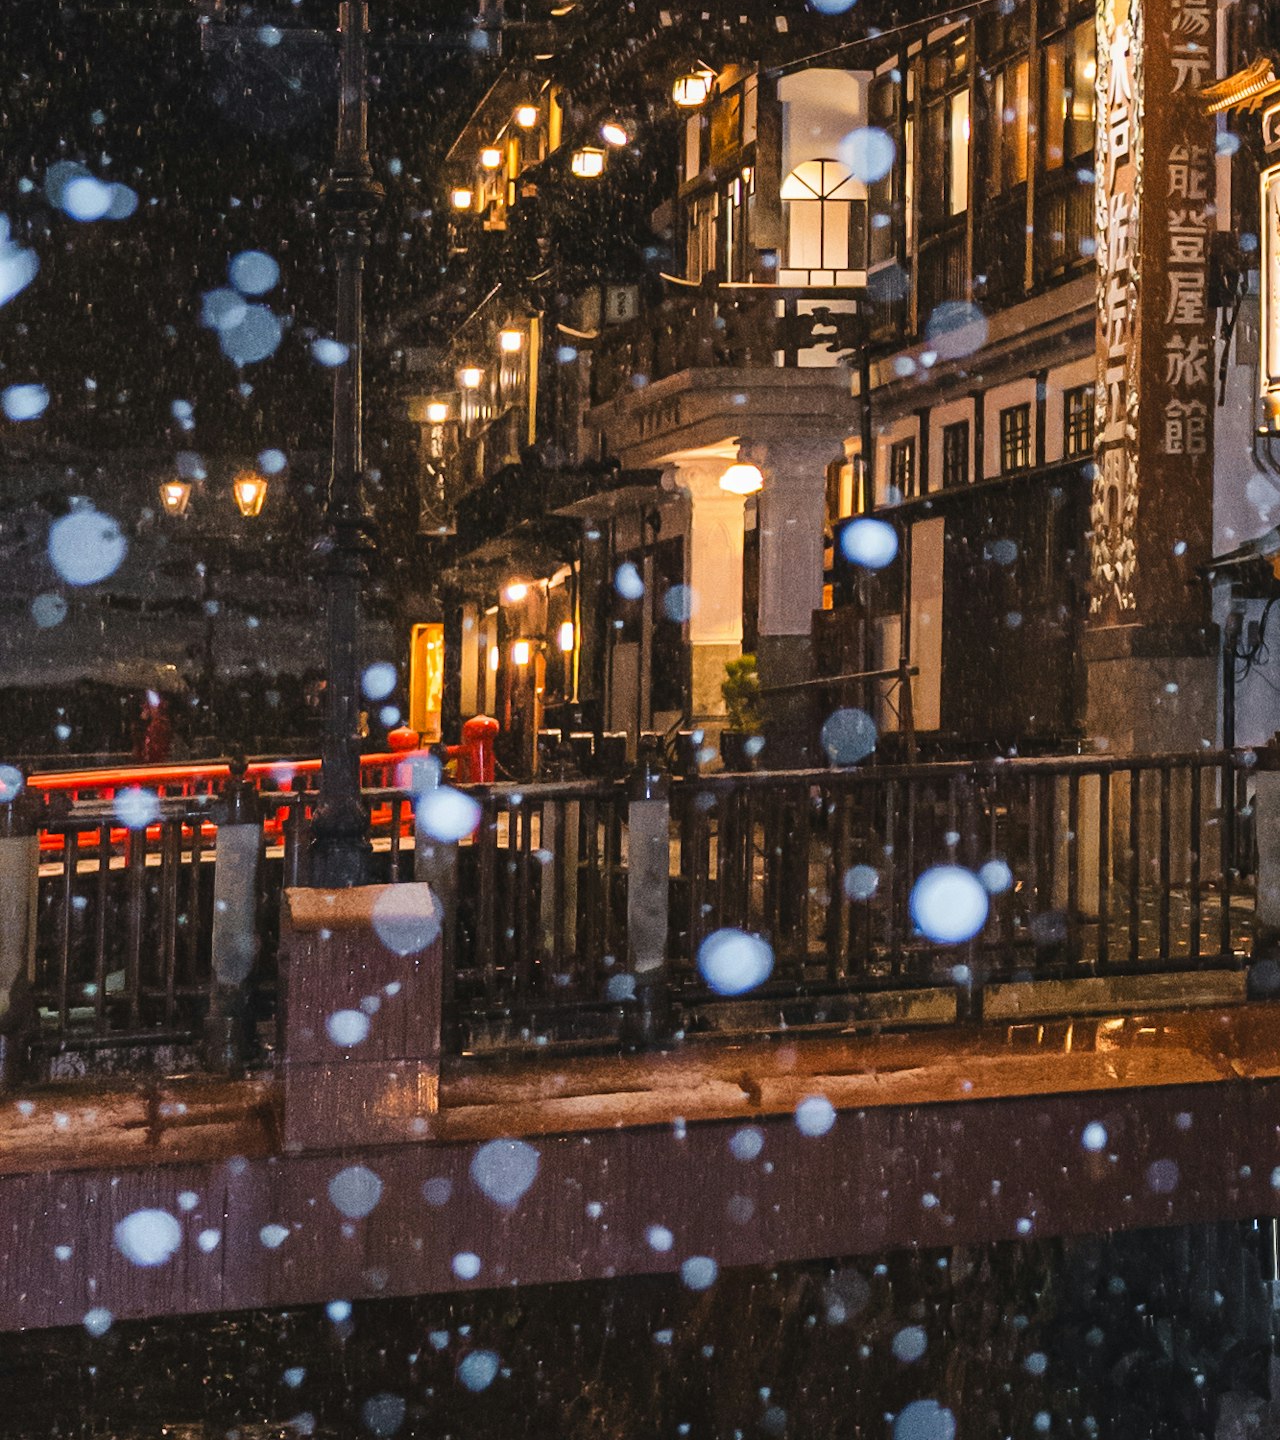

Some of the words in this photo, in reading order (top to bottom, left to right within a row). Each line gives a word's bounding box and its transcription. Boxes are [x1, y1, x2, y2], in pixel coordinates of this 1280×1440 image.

[1164, 142, 1209, 457] 能登屋旅館
